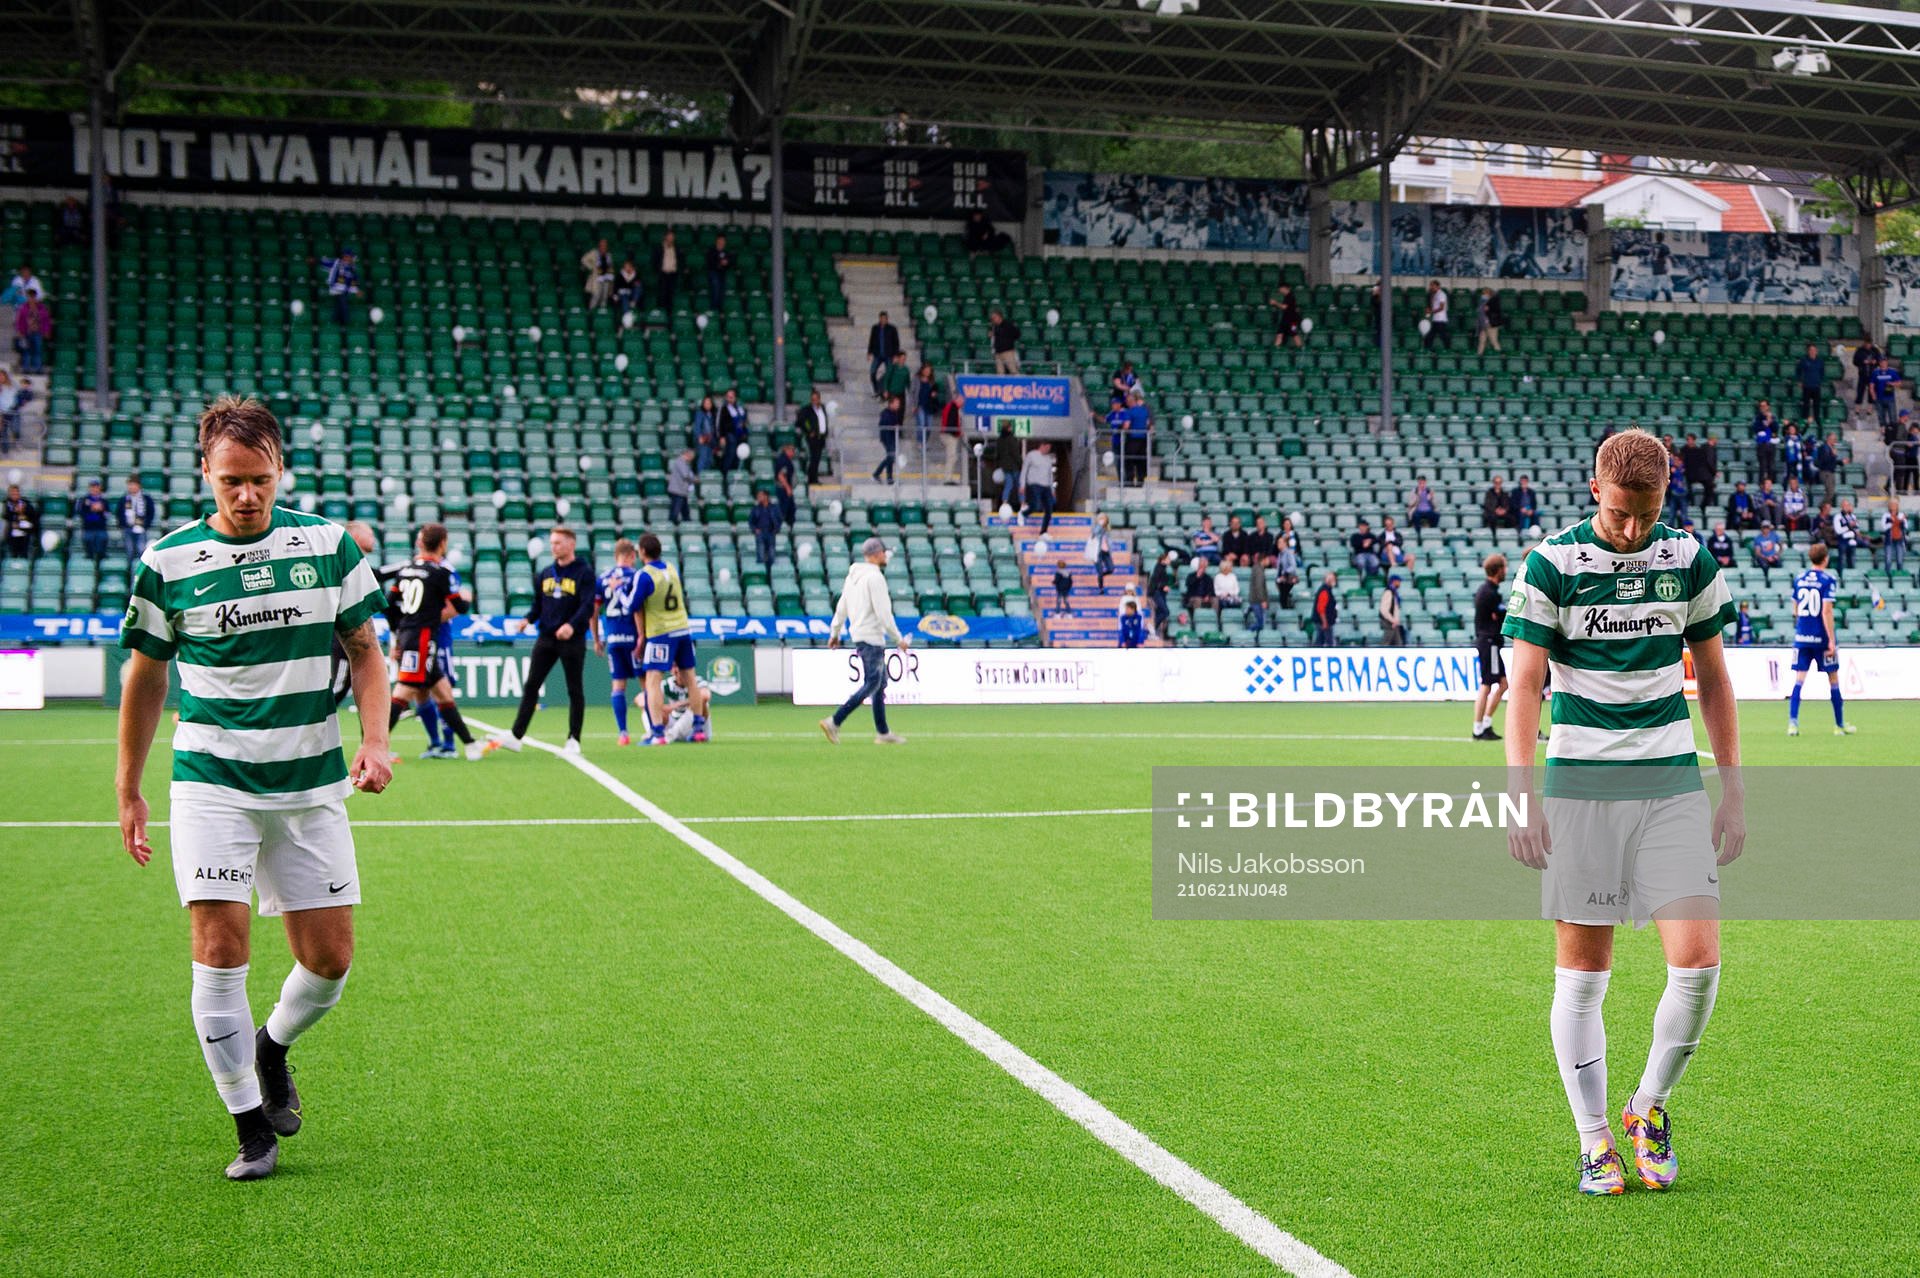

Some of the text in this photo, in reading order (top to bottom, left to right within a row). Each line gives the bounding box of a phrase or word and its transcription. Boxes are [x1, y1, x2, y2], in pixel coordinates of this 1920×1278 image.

[73, 126, 197, 179] MOT
[211, 132, 319, 185] NYA
[329, 130, 459, 190] MÅL.
[471, 143, 650, 196] SKARU
[814, 189, 849, 204] ALL
[884, 191, 919, 207] ALL
[953, 193, 988, 209] ALL
[963, 381, 1064, 403] wangeskog
[247, 549, 270, 557] INTER
[260, 567, 271, 579] &
[1619, 578, 1644, 590] Bad &
[399, 578, 424, 614] 30
[665, 584, 678, 611] 6
[1798, 588, 1820, 617] 20
[216, 604, 311, 633] Kinnarps
[1585, 608, 1671, 637] Kinnarps
